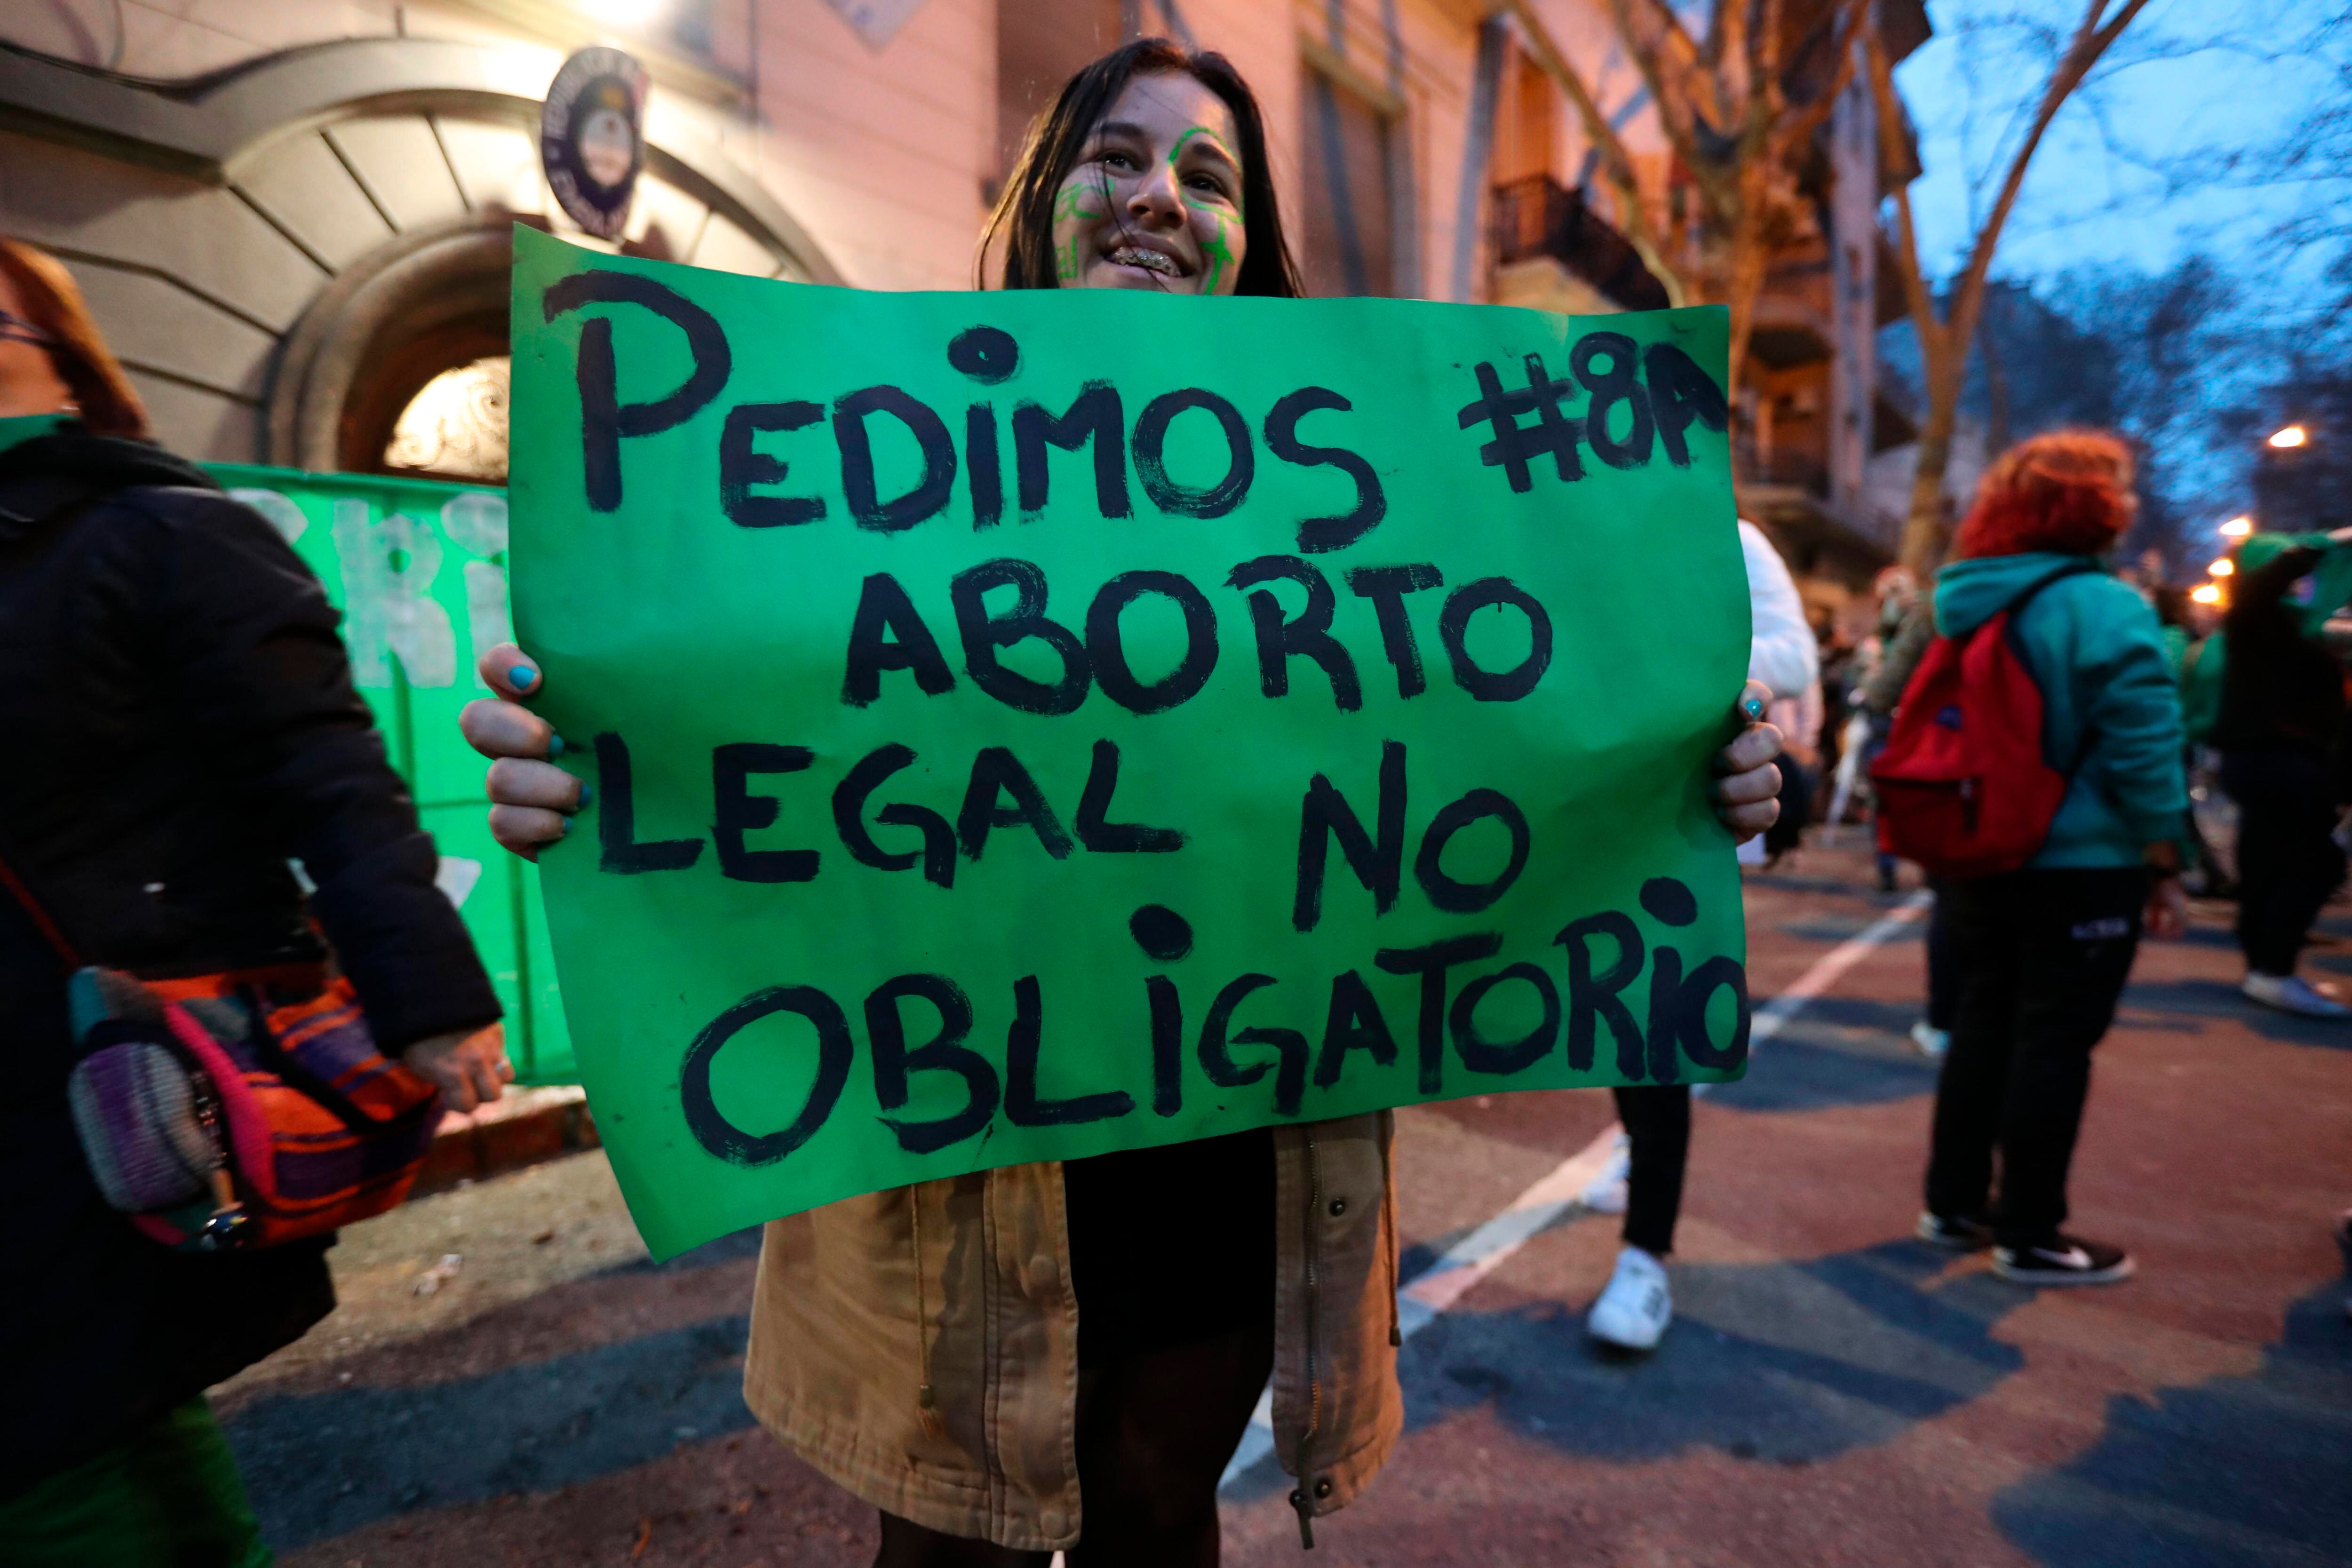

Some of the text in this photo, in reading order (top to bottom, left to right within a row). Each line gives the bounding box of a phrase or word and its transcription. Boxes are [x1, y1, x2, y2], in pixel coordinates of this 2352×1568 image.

[1458, 331, 1729, 493] #8A
[840, 555, 1552, 717] ABORTO
[592, 731, 1530, 933] LEGAL NO
